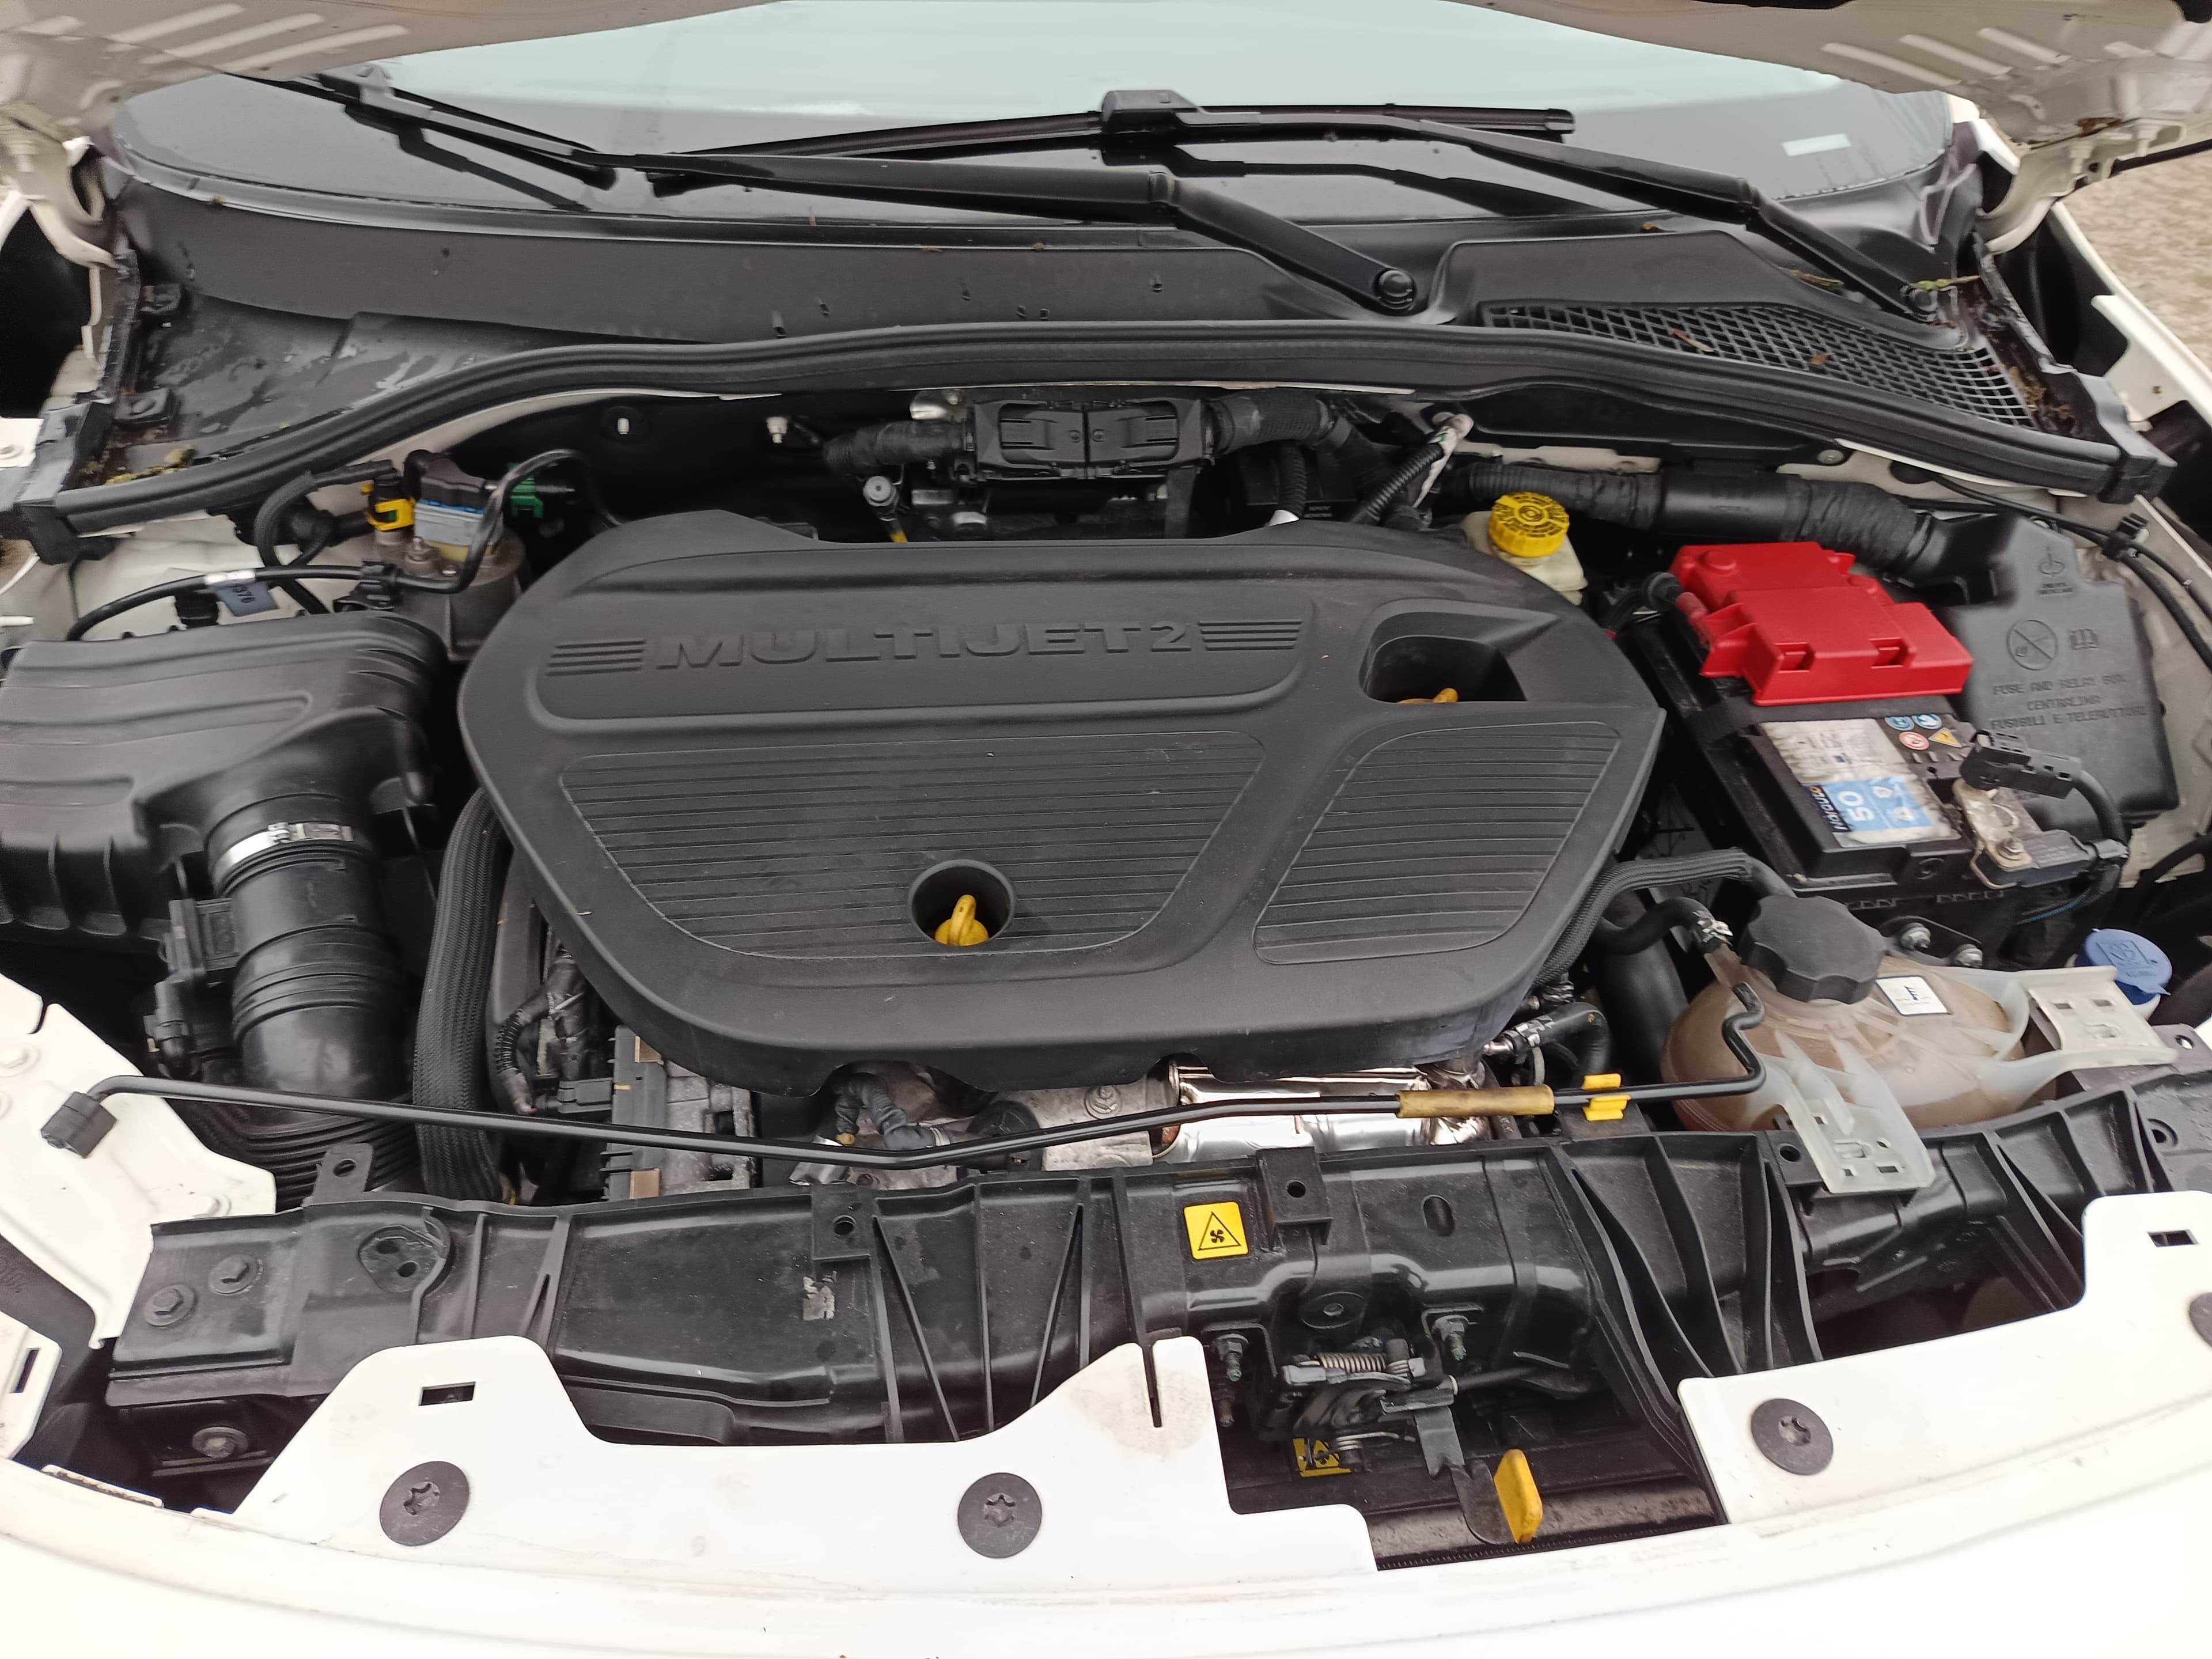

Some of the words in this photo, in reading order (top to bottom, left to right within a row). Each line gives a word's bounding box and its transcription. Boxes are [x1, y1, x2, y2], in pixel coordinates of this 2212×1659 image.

[1992, 683, 2025, 695] FUSE
[2030, 680, 2054, 692] AND
[2052, 714, 2063, 724] E
[1838, 790, 1875, 821] 50
